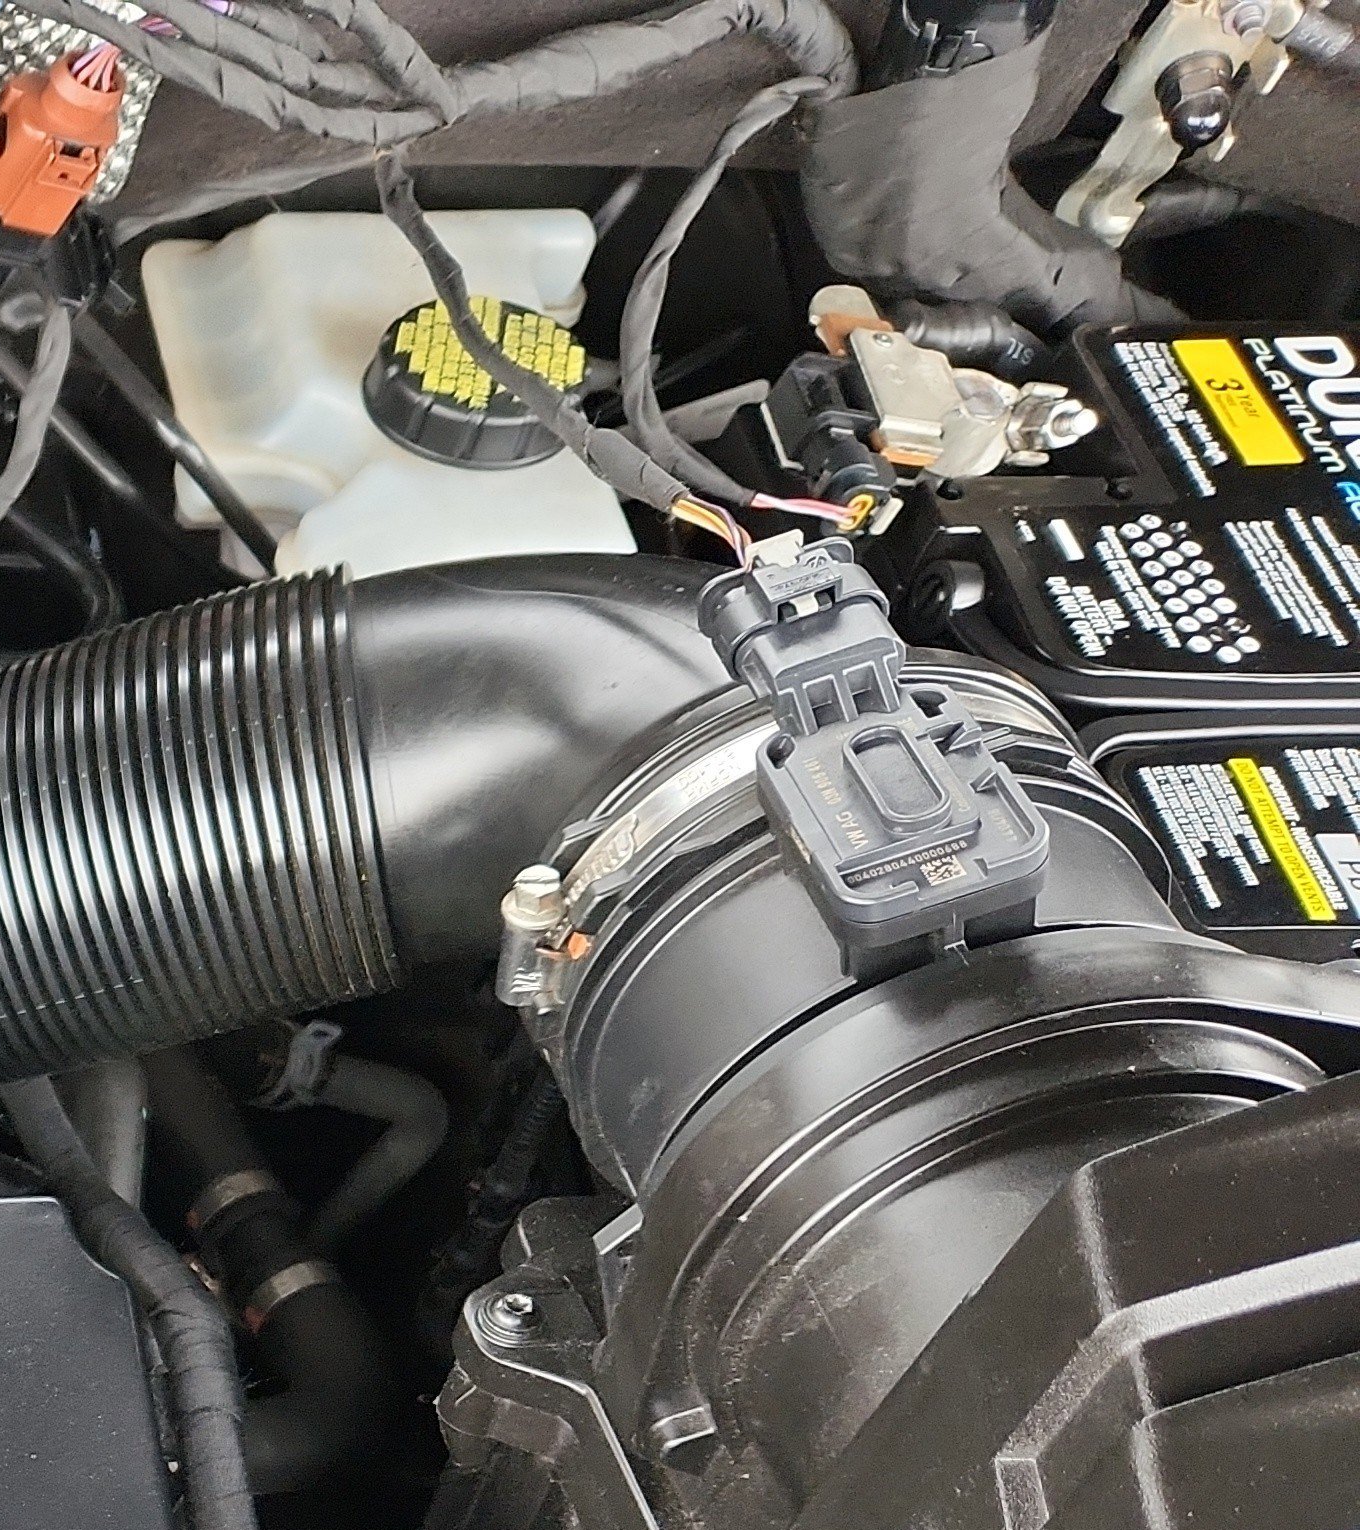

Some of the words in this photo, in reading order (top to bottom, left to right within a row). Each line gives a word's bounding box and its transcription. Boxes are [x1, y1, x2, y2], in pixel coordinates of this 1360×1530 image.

[1242, 338, 1347, 473] PLATINUM
[1045, 576, 1071, 595] DO
[1055, 595, 1086, 619] NOT
[1072, 586, 1115, 634] BATTERY
[1245, 774, 1264, 795] NOT
[1258, 766, 1300, 822] IMPORTANT
[835, 810, 858, 829] AG
[1256, 796, 1286, 840] ATTEMPT
[845, 829, 869, 850] VW
[1277, 841, 1292, 854] TO
[1283, 855, 1306, 879] OPEN
[1297, 881, 1326, 912] VENTS
